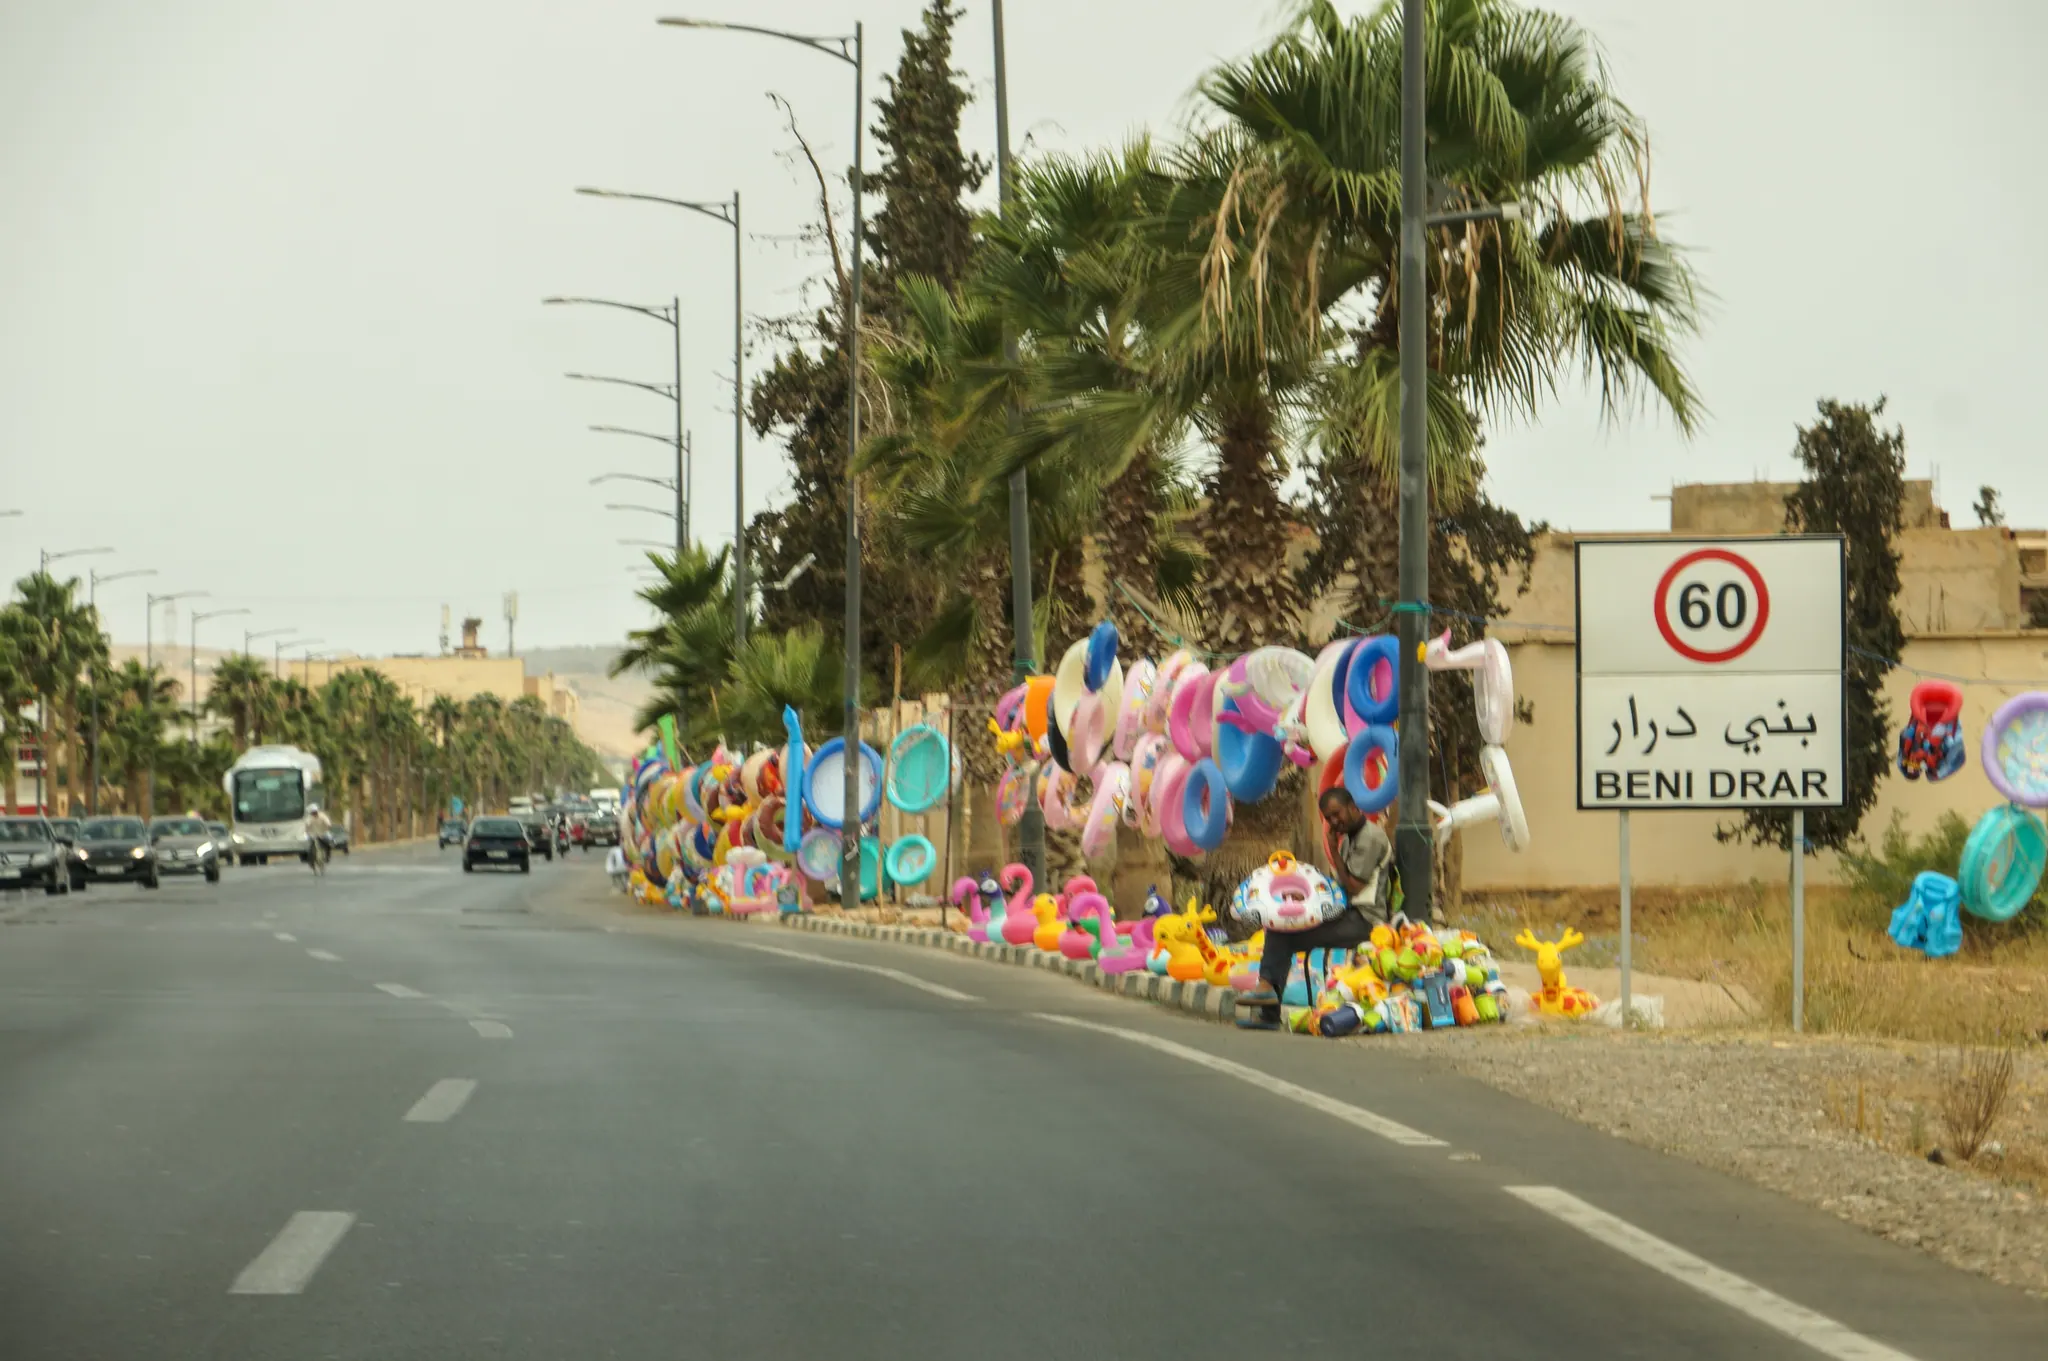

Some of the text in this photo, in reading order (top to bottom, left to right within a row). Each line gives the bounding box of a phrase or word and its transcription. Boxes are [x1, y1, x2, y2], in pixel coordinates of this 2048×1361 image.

[1679, 581, 1747, 630] 60
[1605, 694, 1817, 756] بني درار
[1595, 769, 1829, 800] BENI DRAR
